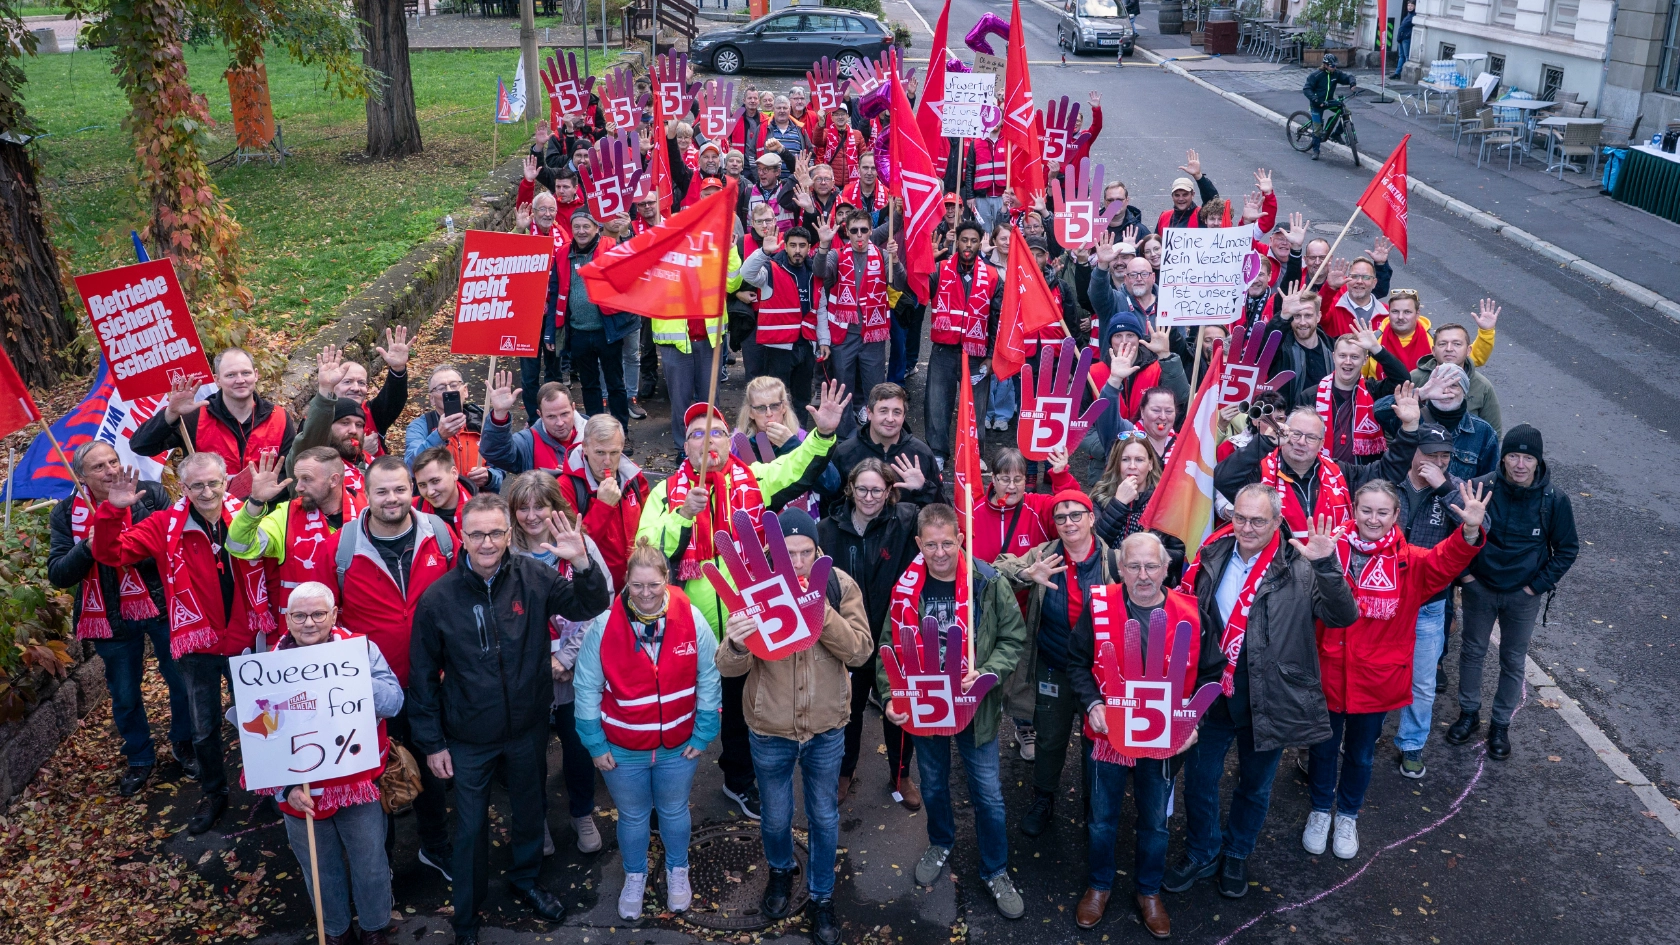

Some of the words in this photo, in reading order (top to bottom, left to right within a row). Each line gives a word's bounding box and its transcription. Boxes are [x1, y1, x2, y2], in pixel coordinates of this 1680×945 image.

[559, 84, 577, 110] 5
[664, 86, 680, 112] 5
[820, 86, 834, 106] 5
[945, 76, 994, 96] ufwertung
[614, 101, 631, 126] 5
[710, 110, 724, 132] 5
[943, 106, 956, 115] eil
[943, 117, 974, 127] emand
[943, 126, 979, 135] setzt!
[1046, 133, 1064, 159] 5
[600, 180, 620, 213] 5
[1387, 183, 1406, 205] METALL
[1069, 205, 1089, 240] 5
[1165, 230, 1204, 250] Keine
[463, 252, 549, 278] Zusammen
[1197, 251, 1242, 264] Verzicht
[88, 276, 168, 321] Betriebe
[461, 276, 510, 303] geht
[1173, 286, 1191, 298] ist
[1199, 289, 1237, 298] unsere
[98, 300, 172, 340] sichern.
[458, 298, 514, 323] mehr.
[105, 318, 177, 362] Zukunft
[114, 337, 197, 380] schaffen.
[1224, 368, 1254, 402] 5
[1036, 402, 1067, 448] 5
[751, 582, 798, 644] 5
[239, 660, 360, 687] Queens
[328, 687, 367, 717] for
[915, 680, 949, 723] 5
[1131, 688, 1166, 742] 5
